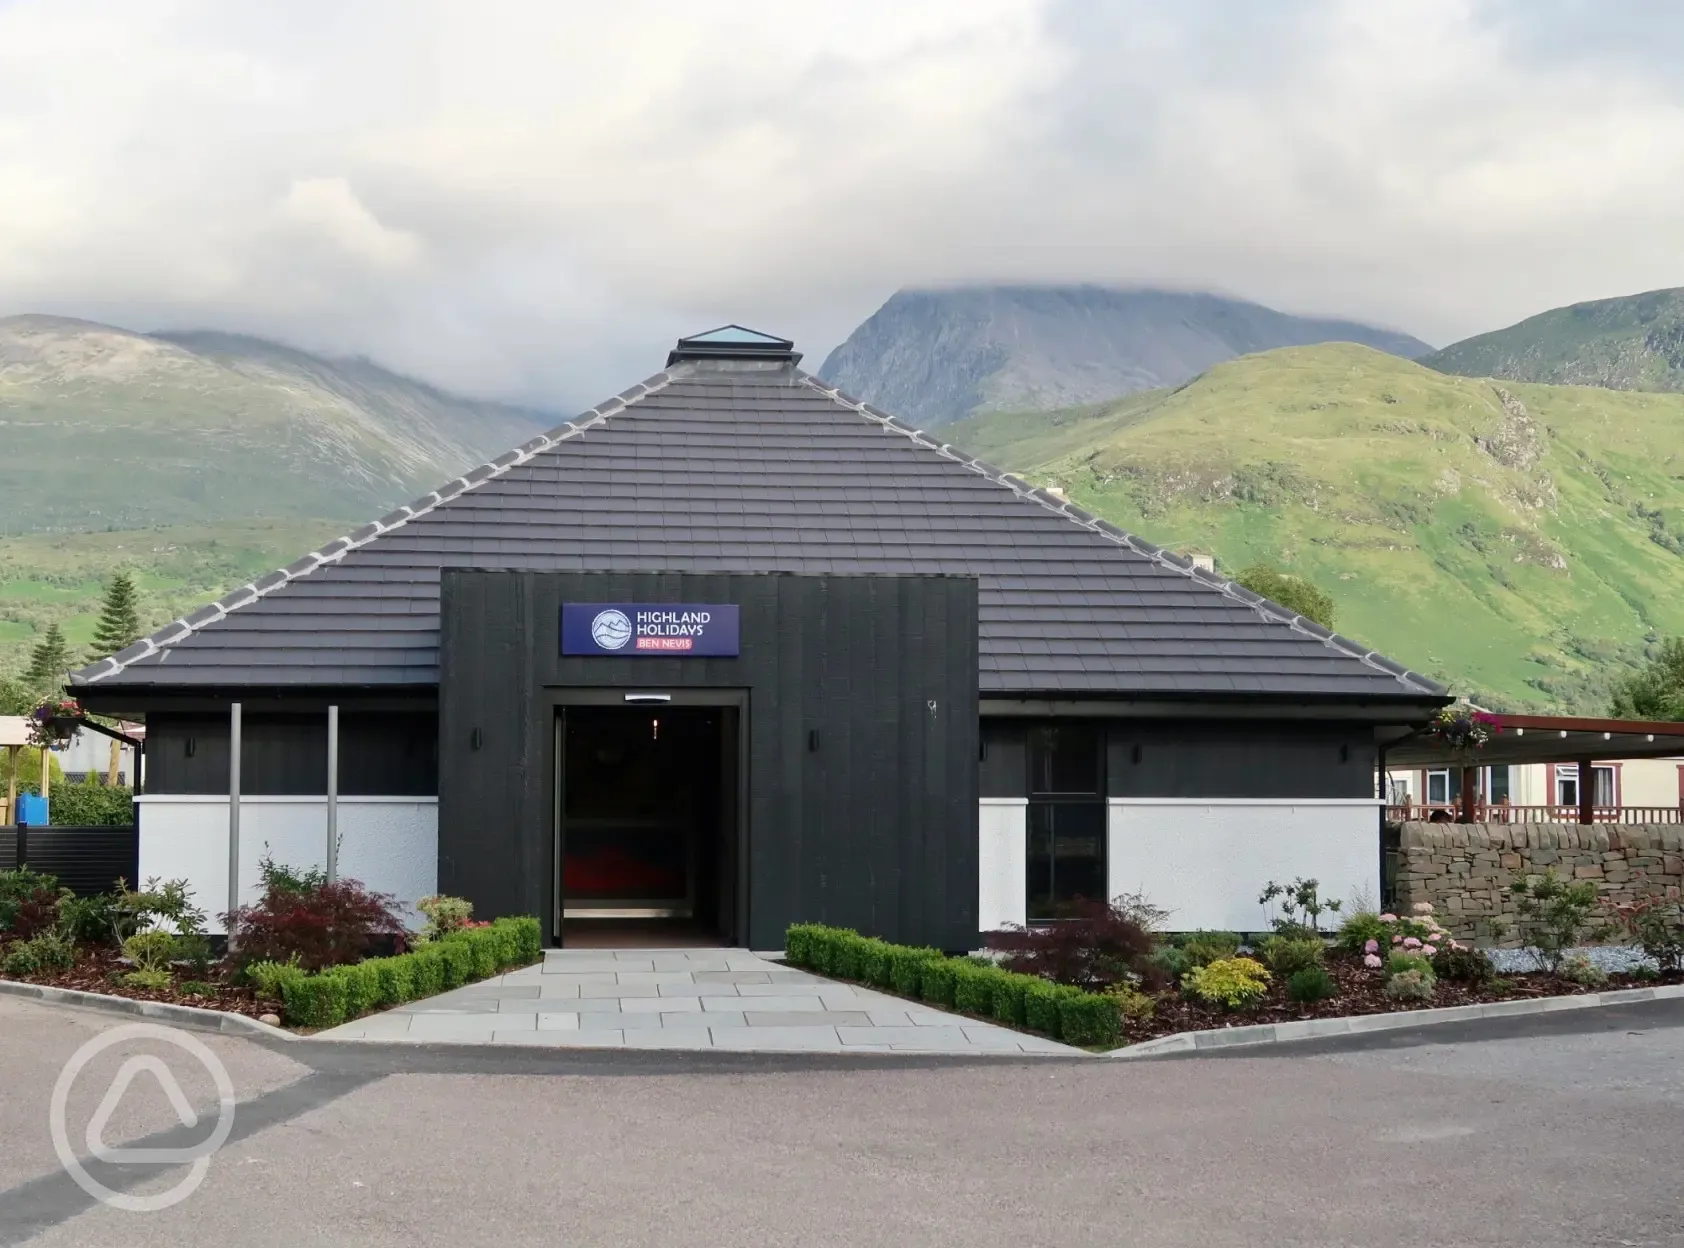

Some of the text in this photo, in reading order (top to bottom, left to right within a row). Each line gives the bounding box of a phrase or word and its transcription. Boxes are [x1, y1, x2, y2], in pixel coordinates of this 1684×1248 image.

[636, 611, 711, 624] HIGHLAND
[636, 624, 703, 636] HOLIDAYS
[638, 639, 691, 648] BEN NEVIS
